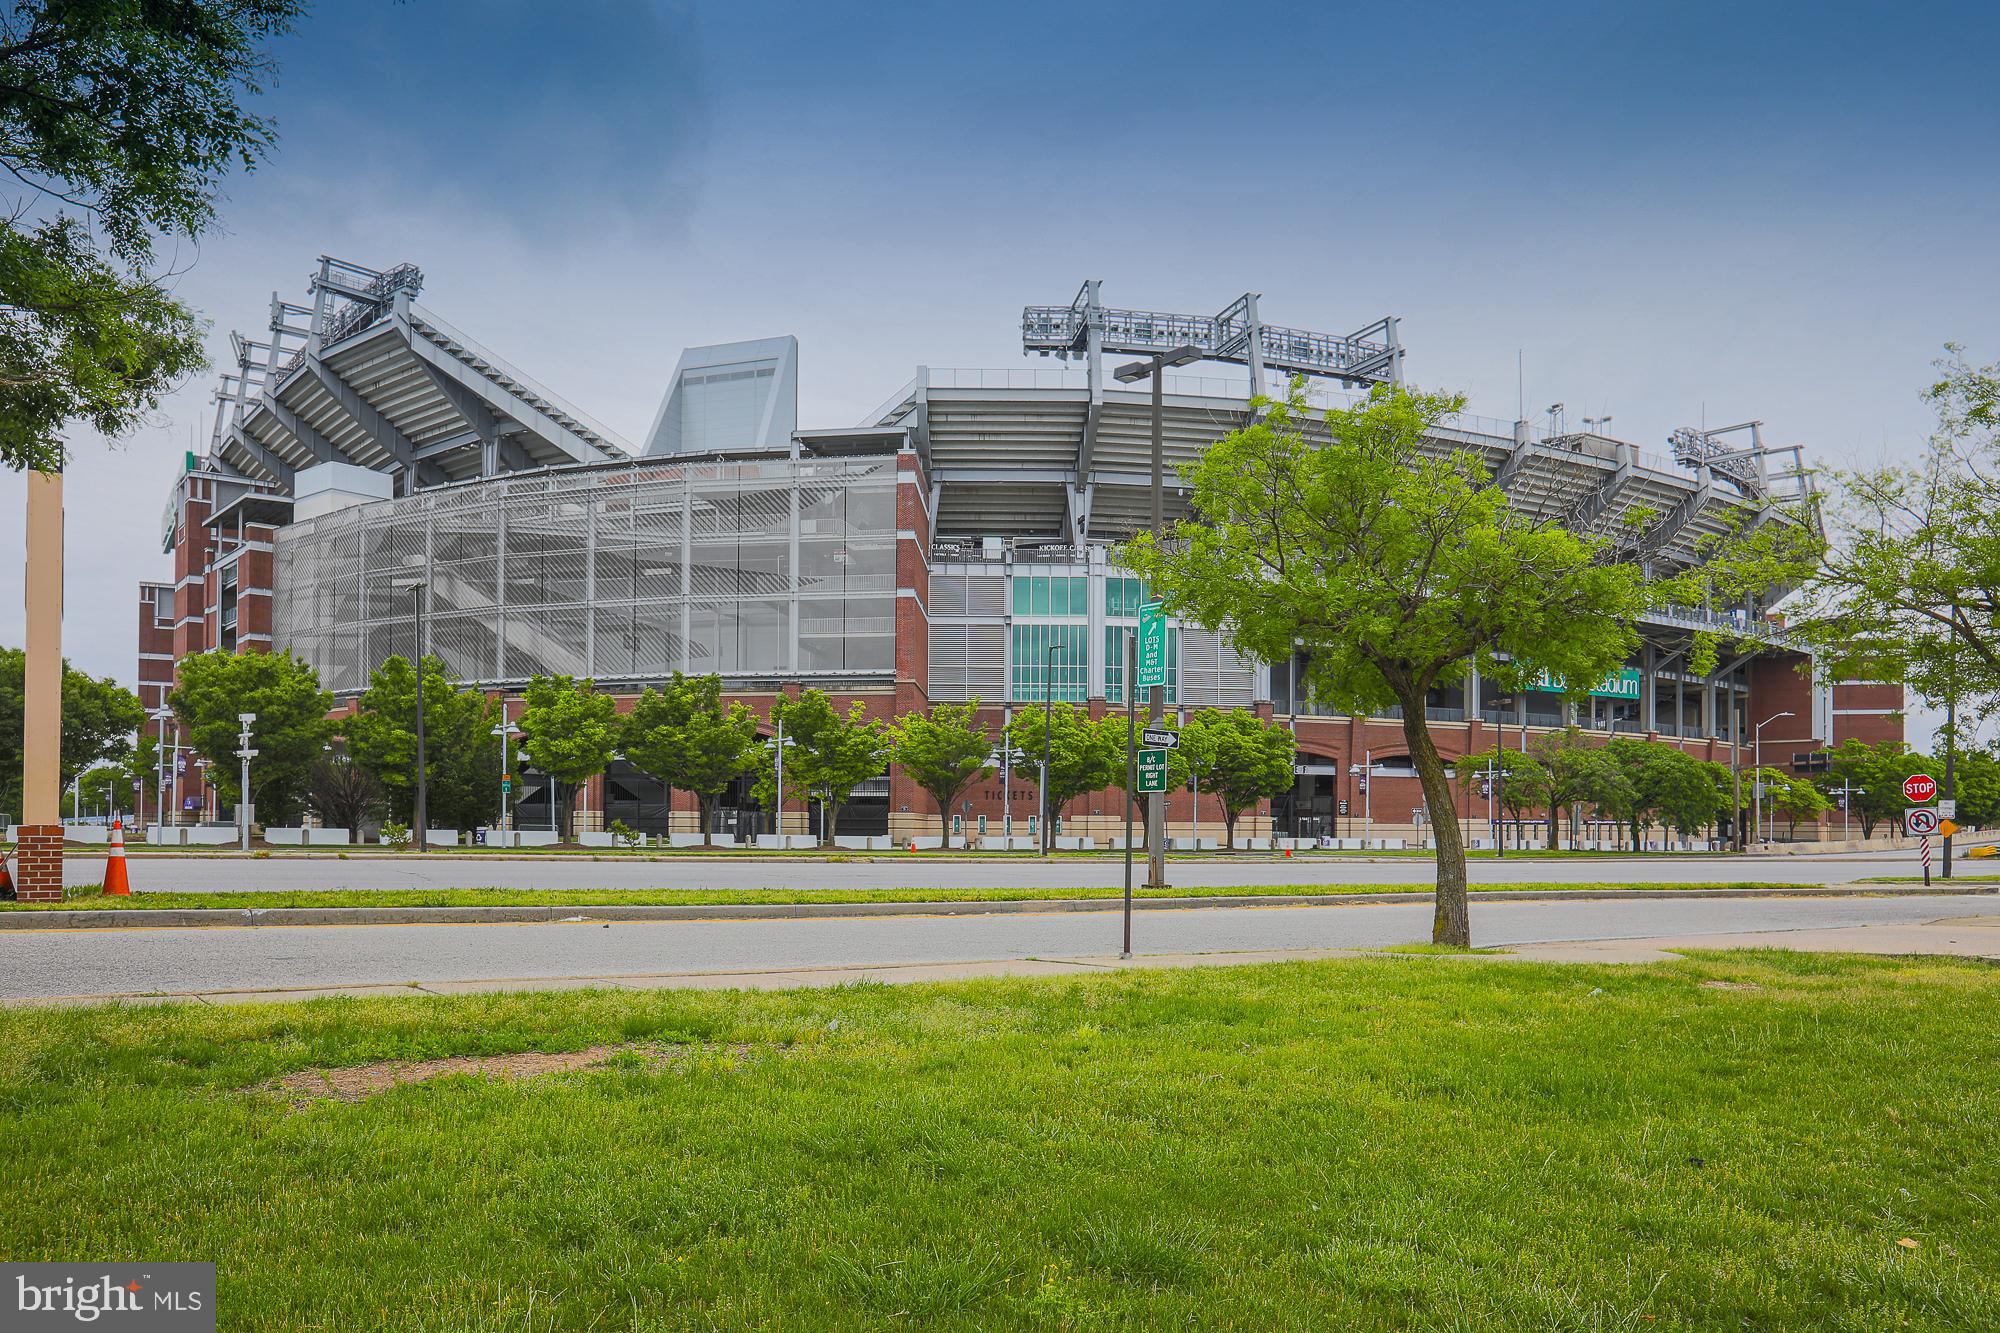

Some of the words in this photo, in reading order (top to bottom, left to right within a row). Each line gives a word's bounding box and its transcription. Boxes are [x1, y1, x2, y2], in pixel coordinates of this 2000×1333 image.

[931, 543, 960, 551] CLASSICS
[1039, 544, 1067, 552] KICKOFF
[1144, 636, 1160, 645] LOTS
[1145, 651, 1158, 659] and
[1145, 659, 1158, 667] M&T
[1140, 666, 1164, 674] Charter
[1142, 674, 1161, 682] Buses
[1146, 734, 1157, 742] ONE
[1906, 782, 1934, 794] STOP
[984, 790, 1033, 800] TICETS
